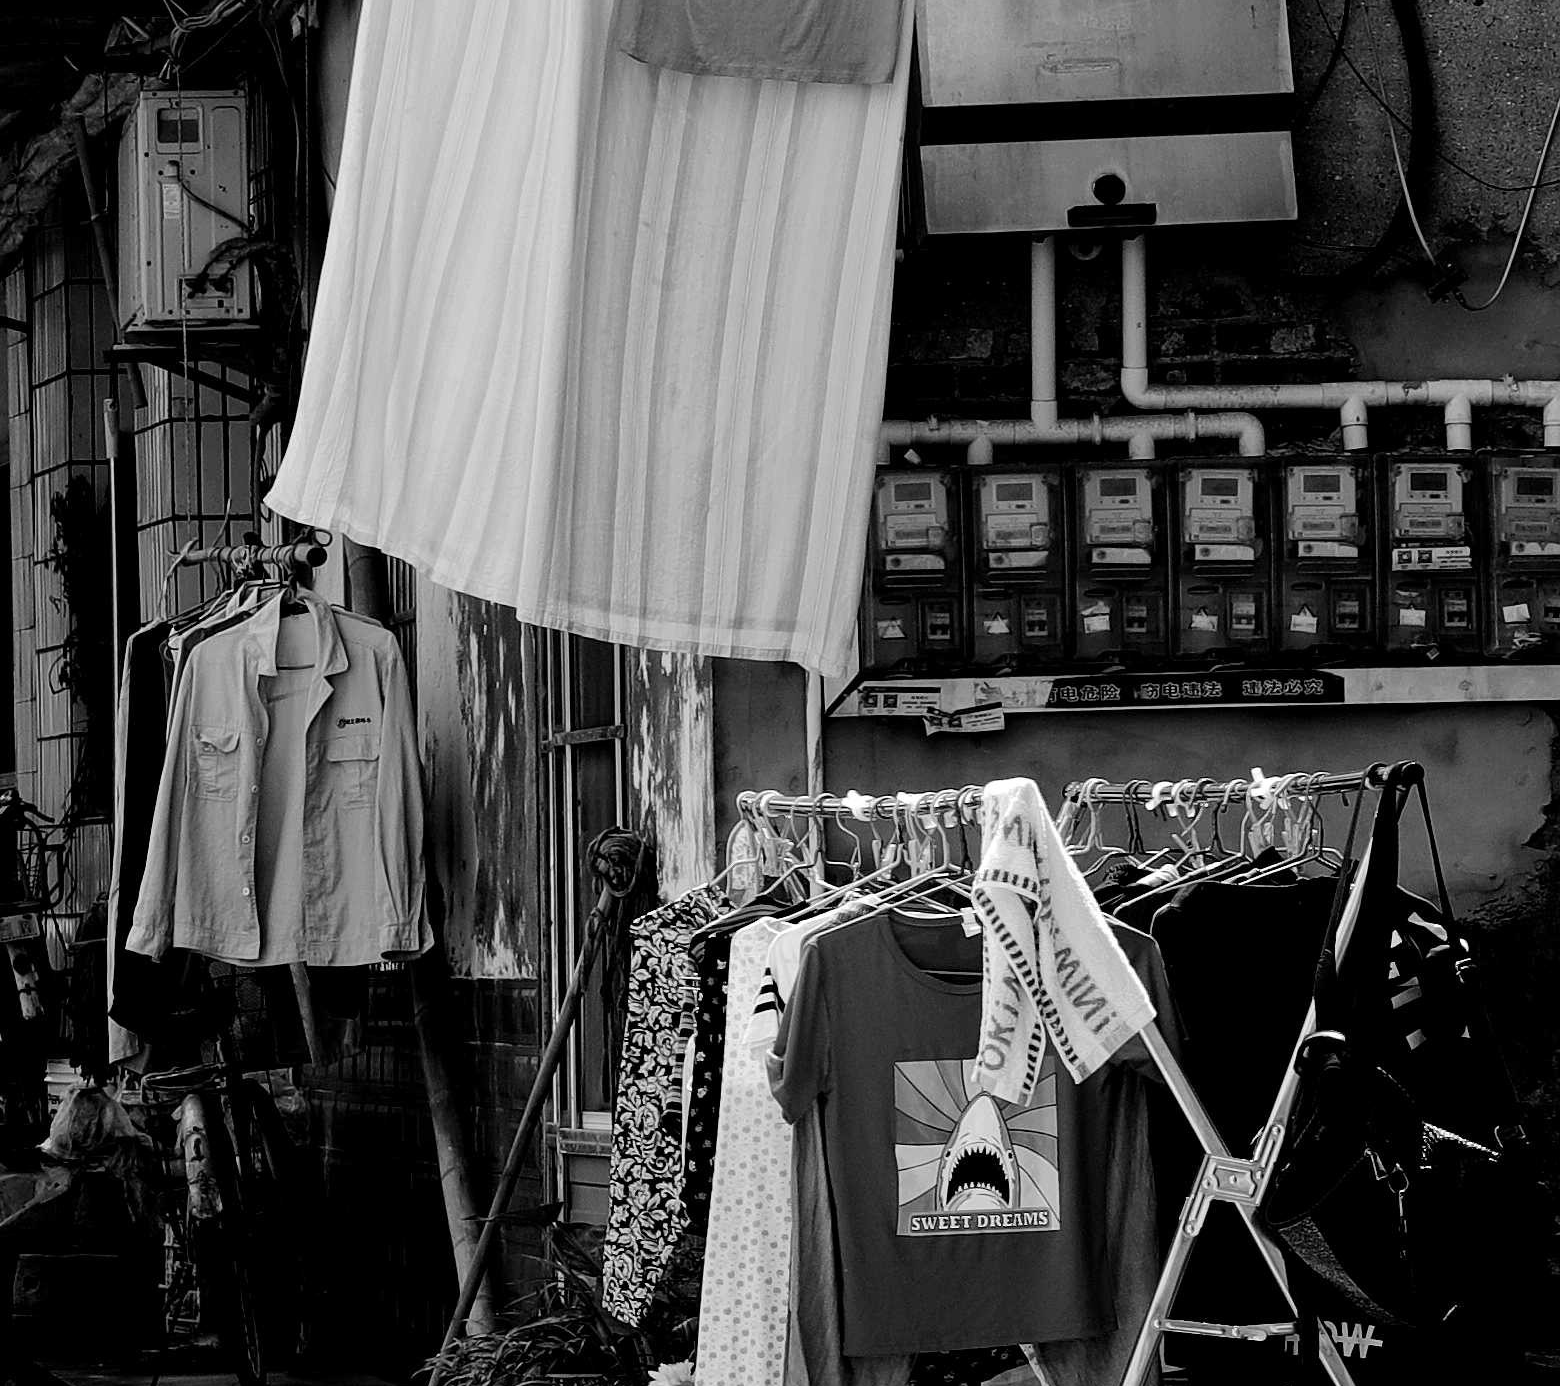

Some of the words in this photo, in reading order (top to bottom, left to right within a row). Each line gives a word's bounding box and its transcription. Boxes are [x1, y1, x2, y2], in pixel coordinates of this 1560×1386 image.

[1241, 677, 1325, 697] 违法必究
[910, 1215, 973, 1232] SWEET
[976, 1210, 1049, 1229] DREAMS
